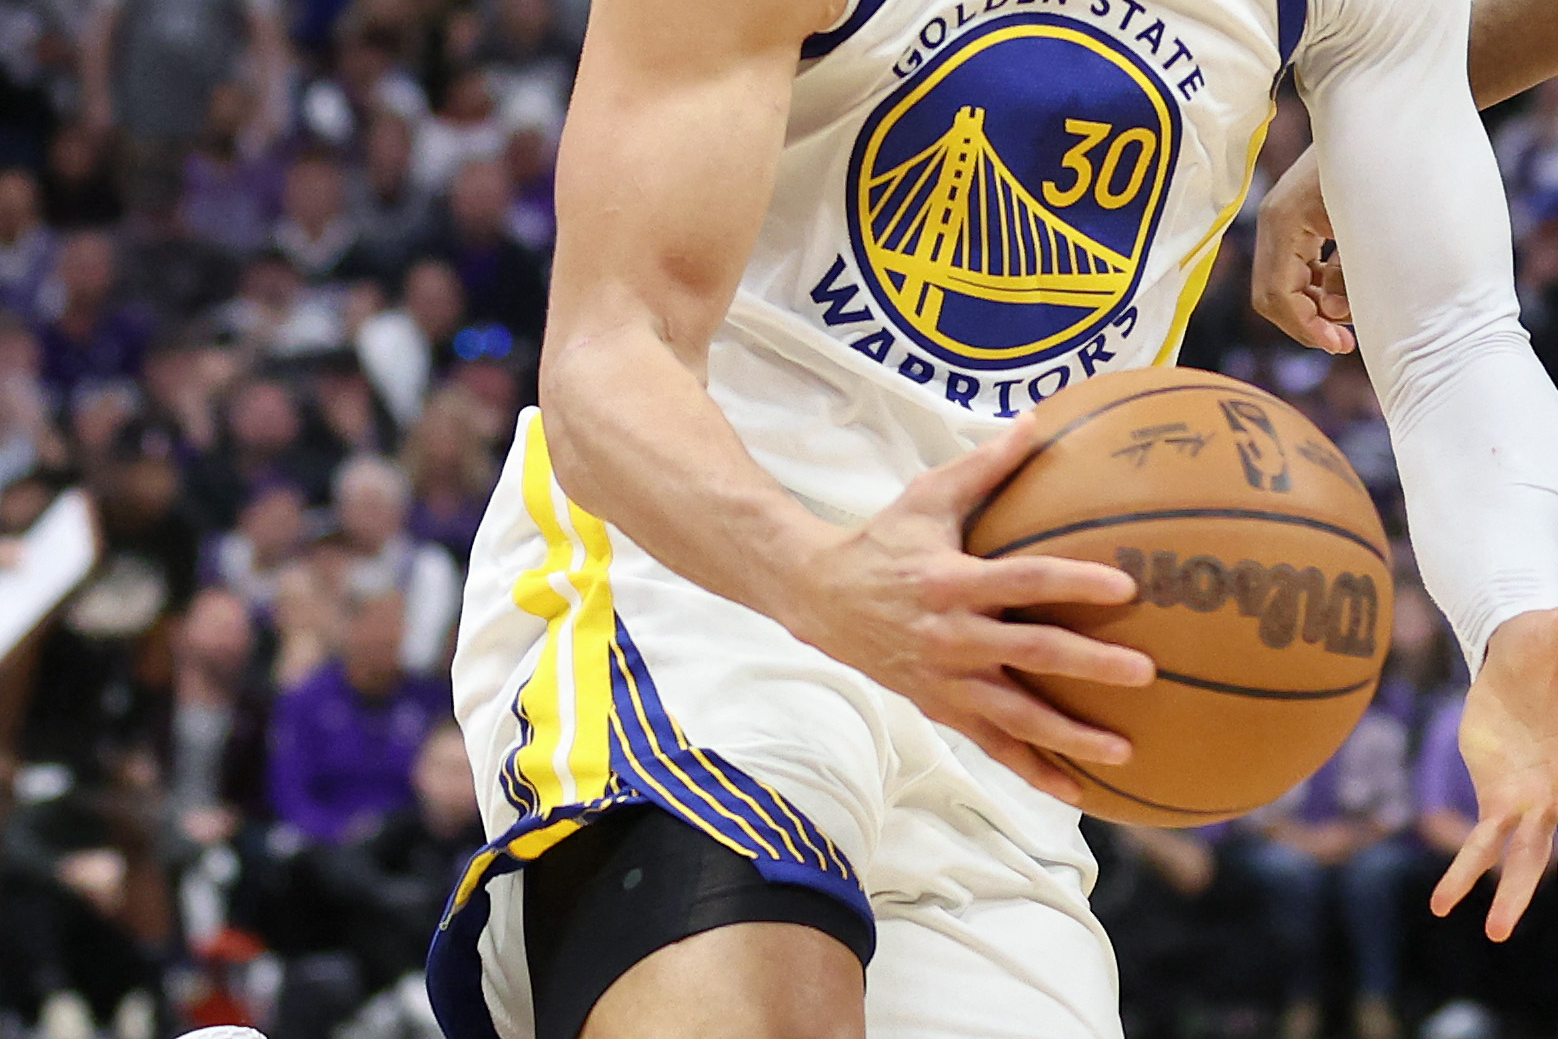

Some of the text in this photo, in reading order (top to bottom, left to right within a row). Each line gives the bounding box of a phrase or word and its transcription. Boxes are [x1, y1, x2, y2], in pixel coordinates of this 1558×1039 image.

[1041, 118, 1158, 210] 30
[810, 253, 1138, 419] WARRIORS
[1116, 546, 1379, 658] Wilson
